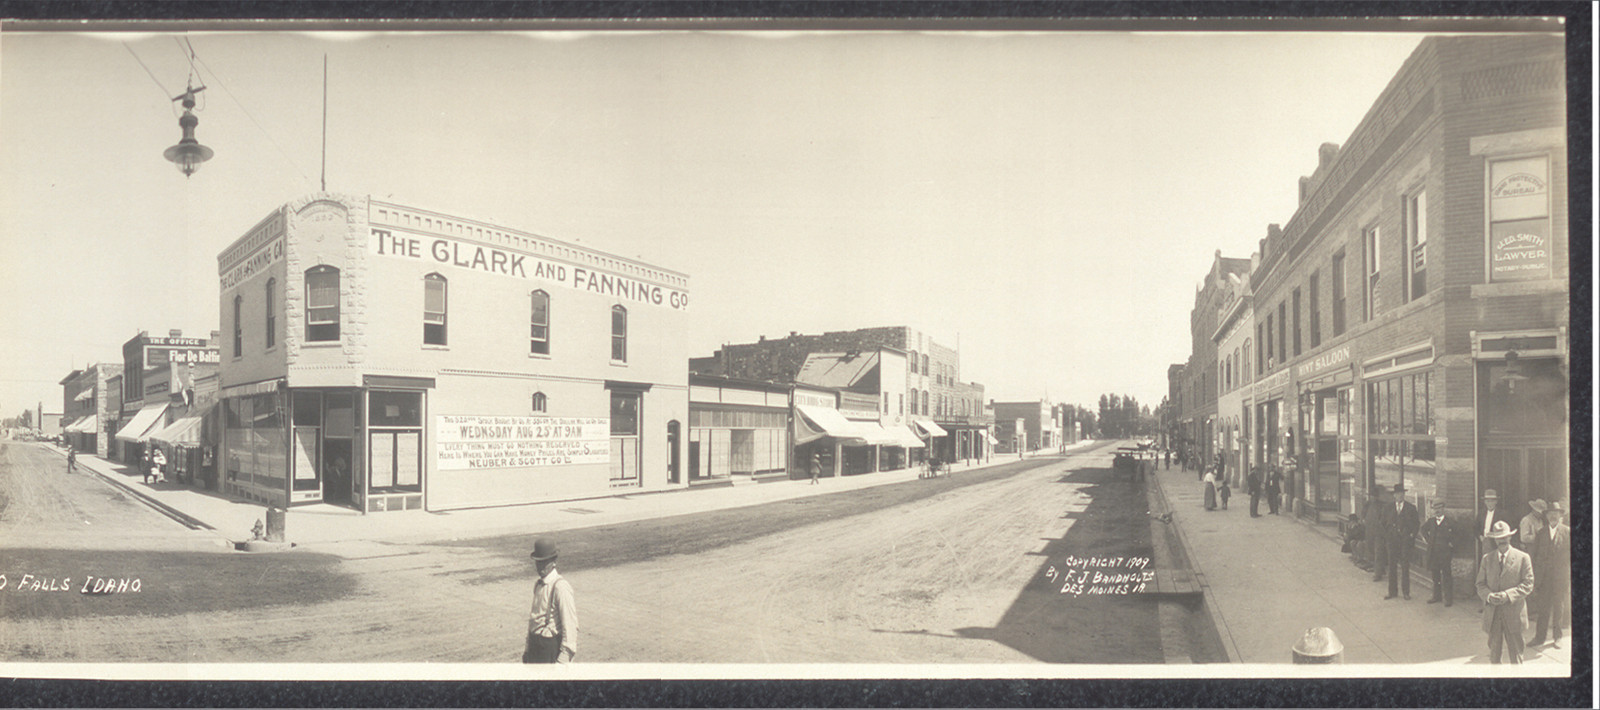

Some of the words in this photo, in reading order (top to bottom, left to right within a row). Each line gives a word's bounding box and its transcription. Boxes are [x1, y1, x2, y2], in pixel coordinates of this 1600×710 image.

[1516, 233, 1544, 246] SMITH
[371, 228, 421, 258] THE
[431, 239, 527, 278] CLARK
[535, 261, 566, 282] AND
[574, 268, 663, 305] FANNING
[169, 350, 186, 362] Flor
[187, 350, 198, 362] De
[1315, 346, 1350, 371] SALOON
[460, 426, 513, 439] WEDNSDAY
[516, 426, 533, 438] AUG
[553, 426, 562, 438] AT
[469, 458, 507, 468] NEUBER
[509, 458, 516, 466] &
[518, 457, 547, 466] SCOTT
[550, 456, 561, 464] CO
